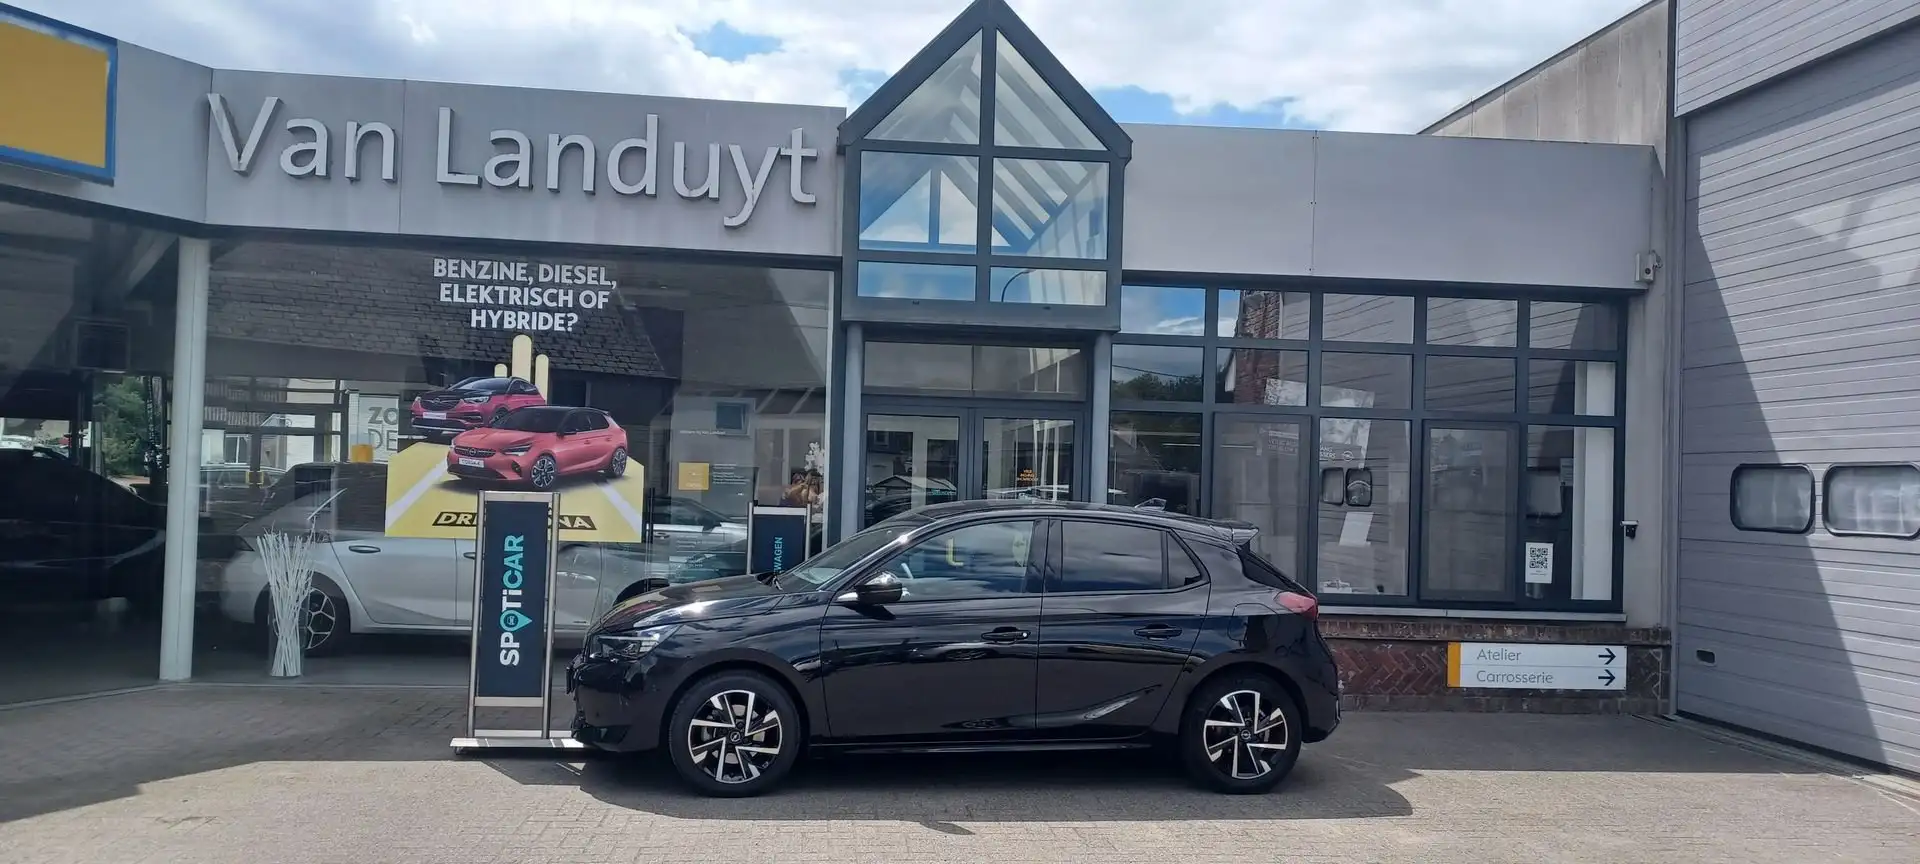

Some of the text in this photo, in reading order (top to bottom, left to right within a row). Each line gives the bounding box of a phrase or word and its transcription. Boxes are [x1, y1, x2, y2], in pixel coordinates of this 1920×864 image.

[207, 93, 818, 228] Van Landuyt
[433, 258, 617, 289] BENZINE, DIESEL,
[439, 283, 610, 309] ELEKTRISCH OF
[470, 308, 579, 332] HYBRIDE?
[1476, 648, 1522, 661] Atelier
[1476, 670, 1554, 683] Carrosserie
